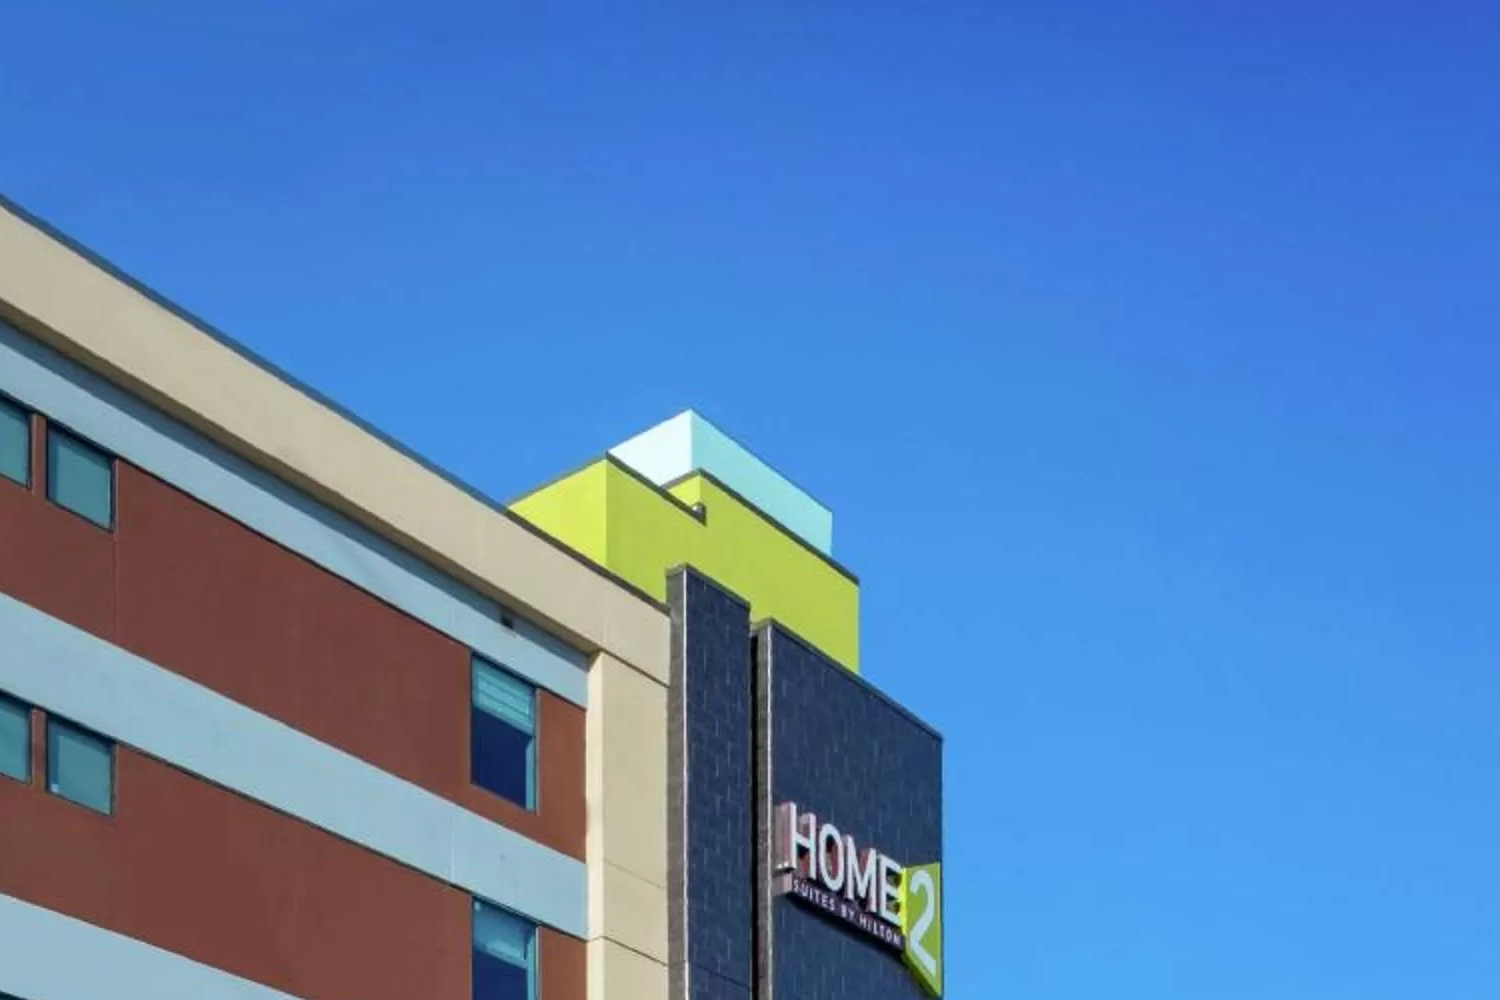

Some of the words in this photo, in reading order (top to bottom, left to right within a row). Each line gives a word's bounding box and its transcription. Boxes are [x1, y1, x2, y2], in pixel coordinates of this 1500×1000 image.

[793, 879, 836, 911] SUITES
[840, 904, 855, 920] BY
[859, 914, 902, 945] HILTON
